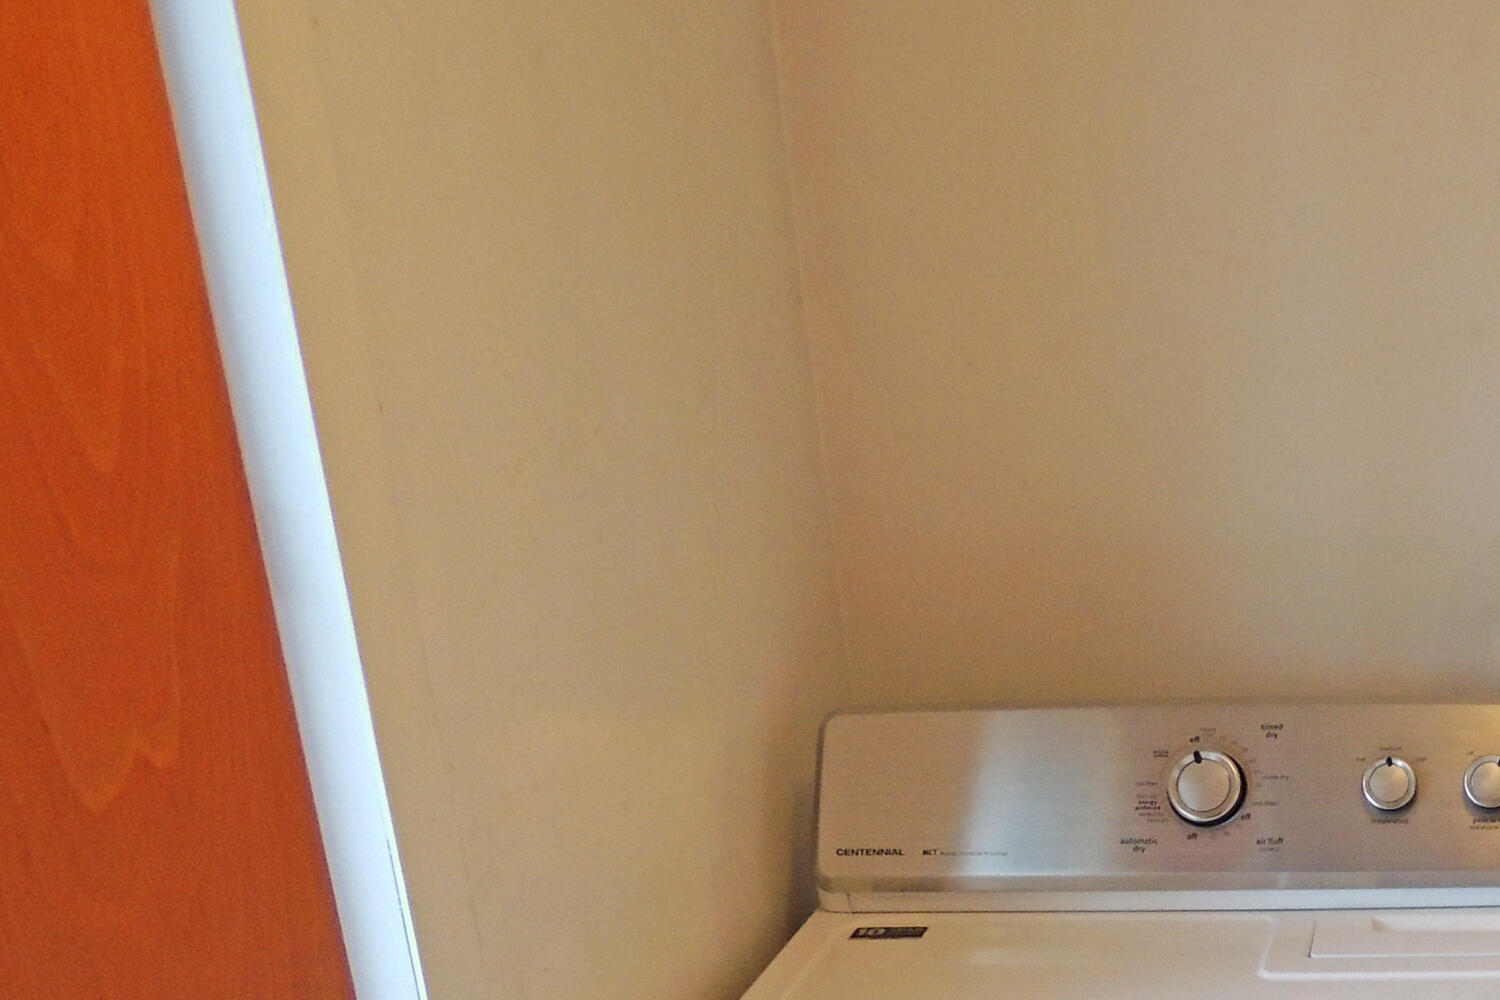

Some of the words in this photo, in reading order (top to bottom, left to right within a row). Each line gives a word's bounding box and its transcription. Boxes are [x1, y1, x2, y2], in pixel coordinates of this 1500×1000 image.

[1265, 731, 1278, 739] dry
[1120, 836, 1158, 845] automatic
[1256, 837, 1266, 845] air
[1268, 836, 1284, 845] fluff
[835, 848, 905, 857] CENTENNIAL
[1132, 845, 1146, 853] dry
